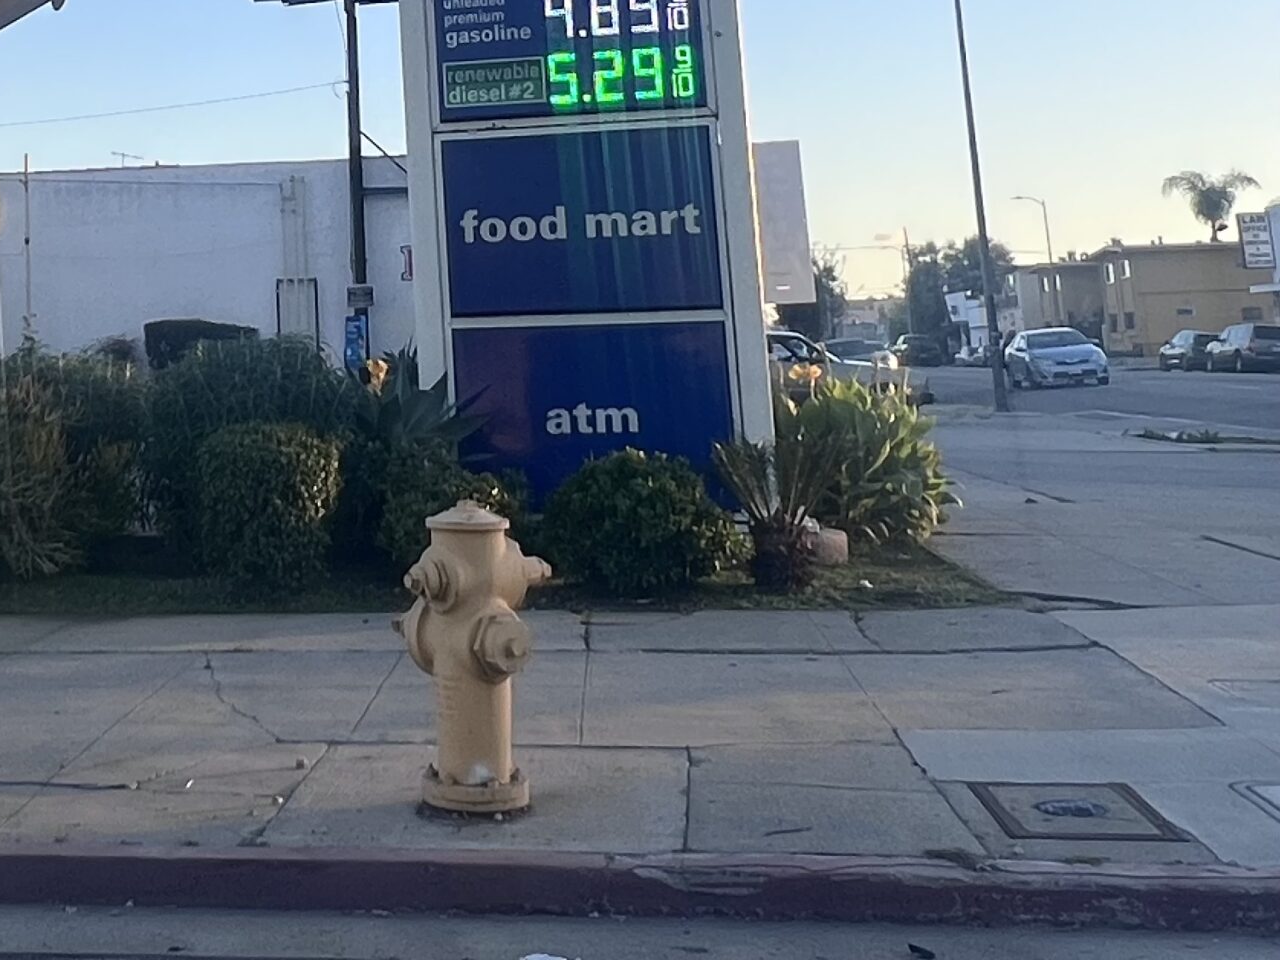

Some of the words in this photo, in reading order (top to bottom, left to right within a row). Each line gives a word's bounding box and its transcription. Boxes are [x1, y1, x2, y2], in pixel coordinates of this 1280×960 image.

[444, 10, 505, 28] premium
[445, 24, 532, 48] gasoline
[447, 63, 540, 86] renewable
[546, 46, 664, 105] 5.29
[448, 81, 507, 104] diesel
[459, 206, 567, 243] food
[584, 202, 701, 238] mart
[545, 402, 639, 435] atm
